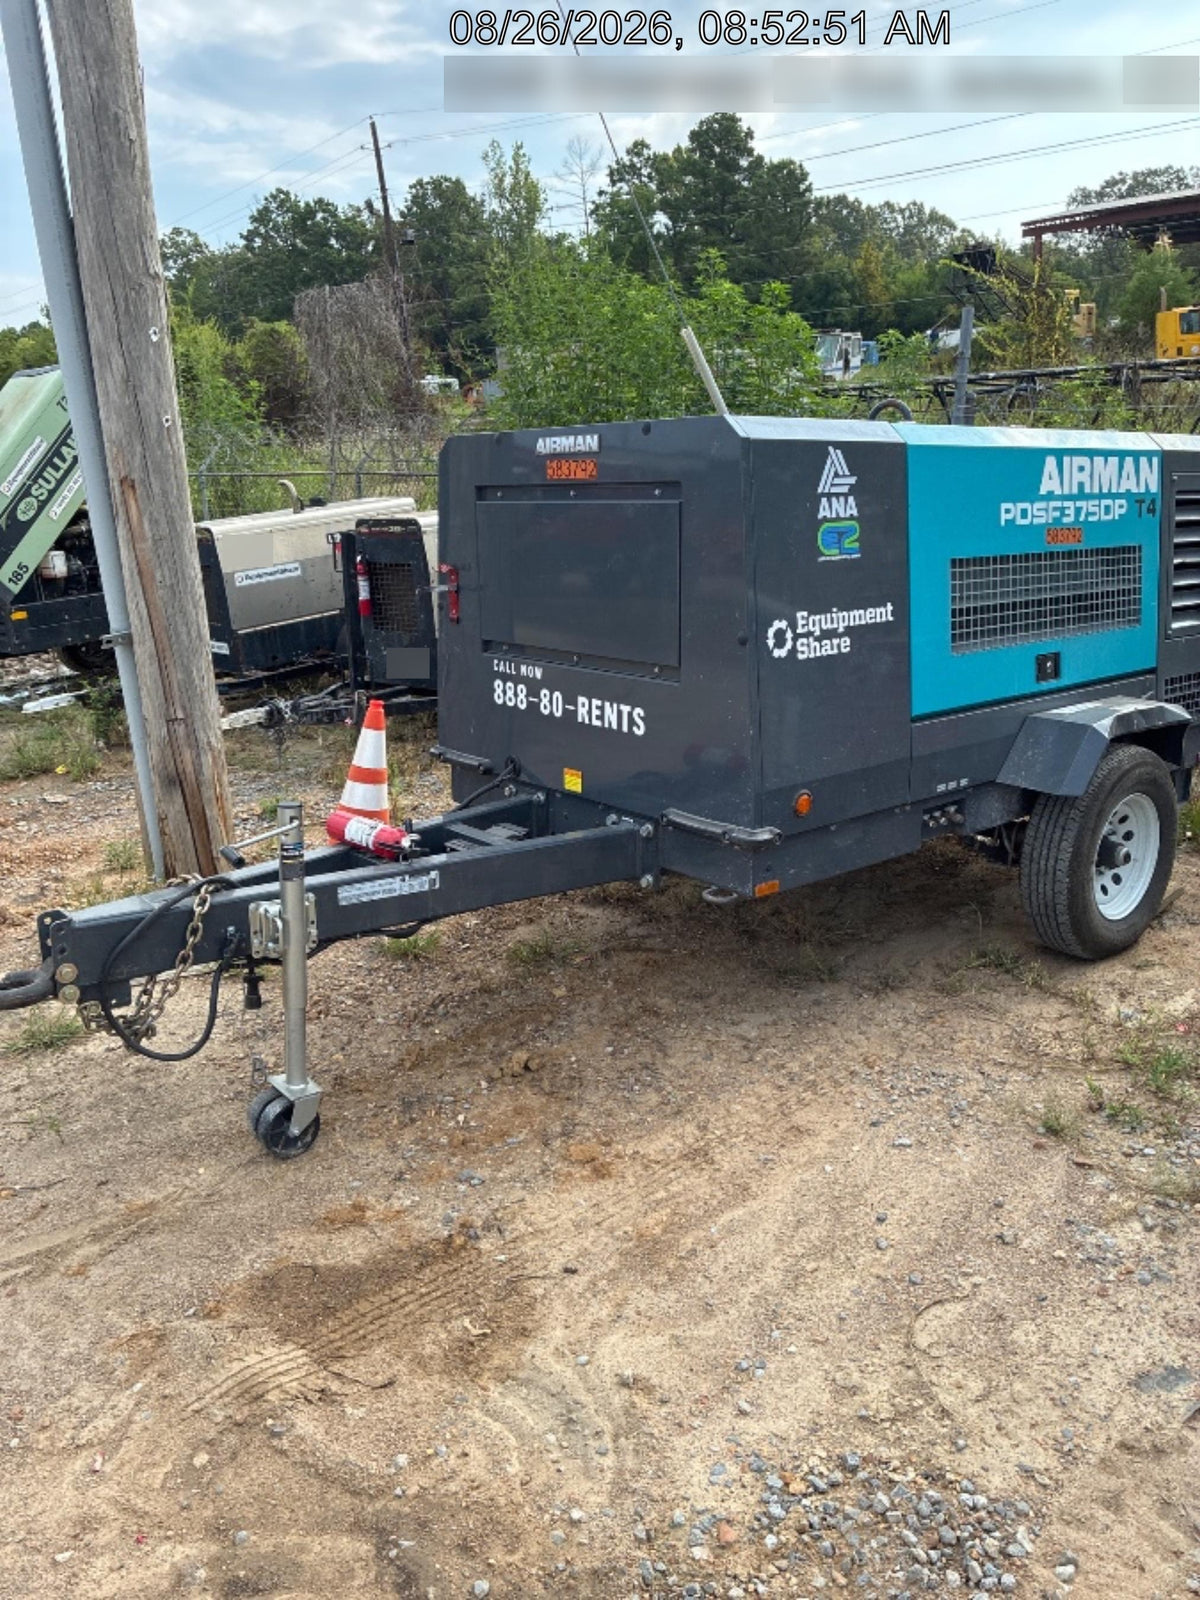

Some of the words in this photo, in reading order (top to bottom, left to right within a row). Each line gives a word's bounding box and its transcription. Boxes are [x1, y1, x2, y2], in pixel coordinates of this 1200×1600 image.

[536, 434, 600, 455] AIRMAN
[547, 459, 597, 478] 583792
[1038, 455, 1158, 494] AIRMAN
[817, 496, 859, 519] ANA
[1000, 499, 1128, 527] PDSF375DP
[1135, 498, 1157, 518] T4
[8, 561, 29, 586] 185
[796, 602, 894, 636] Equipment
[796, 636, 851, 660] Share
[493, 659, 517, 674] CALL
[520, 664, 543, 680] NOW
[493, 679, 646, 736] 888-80-RENTS
